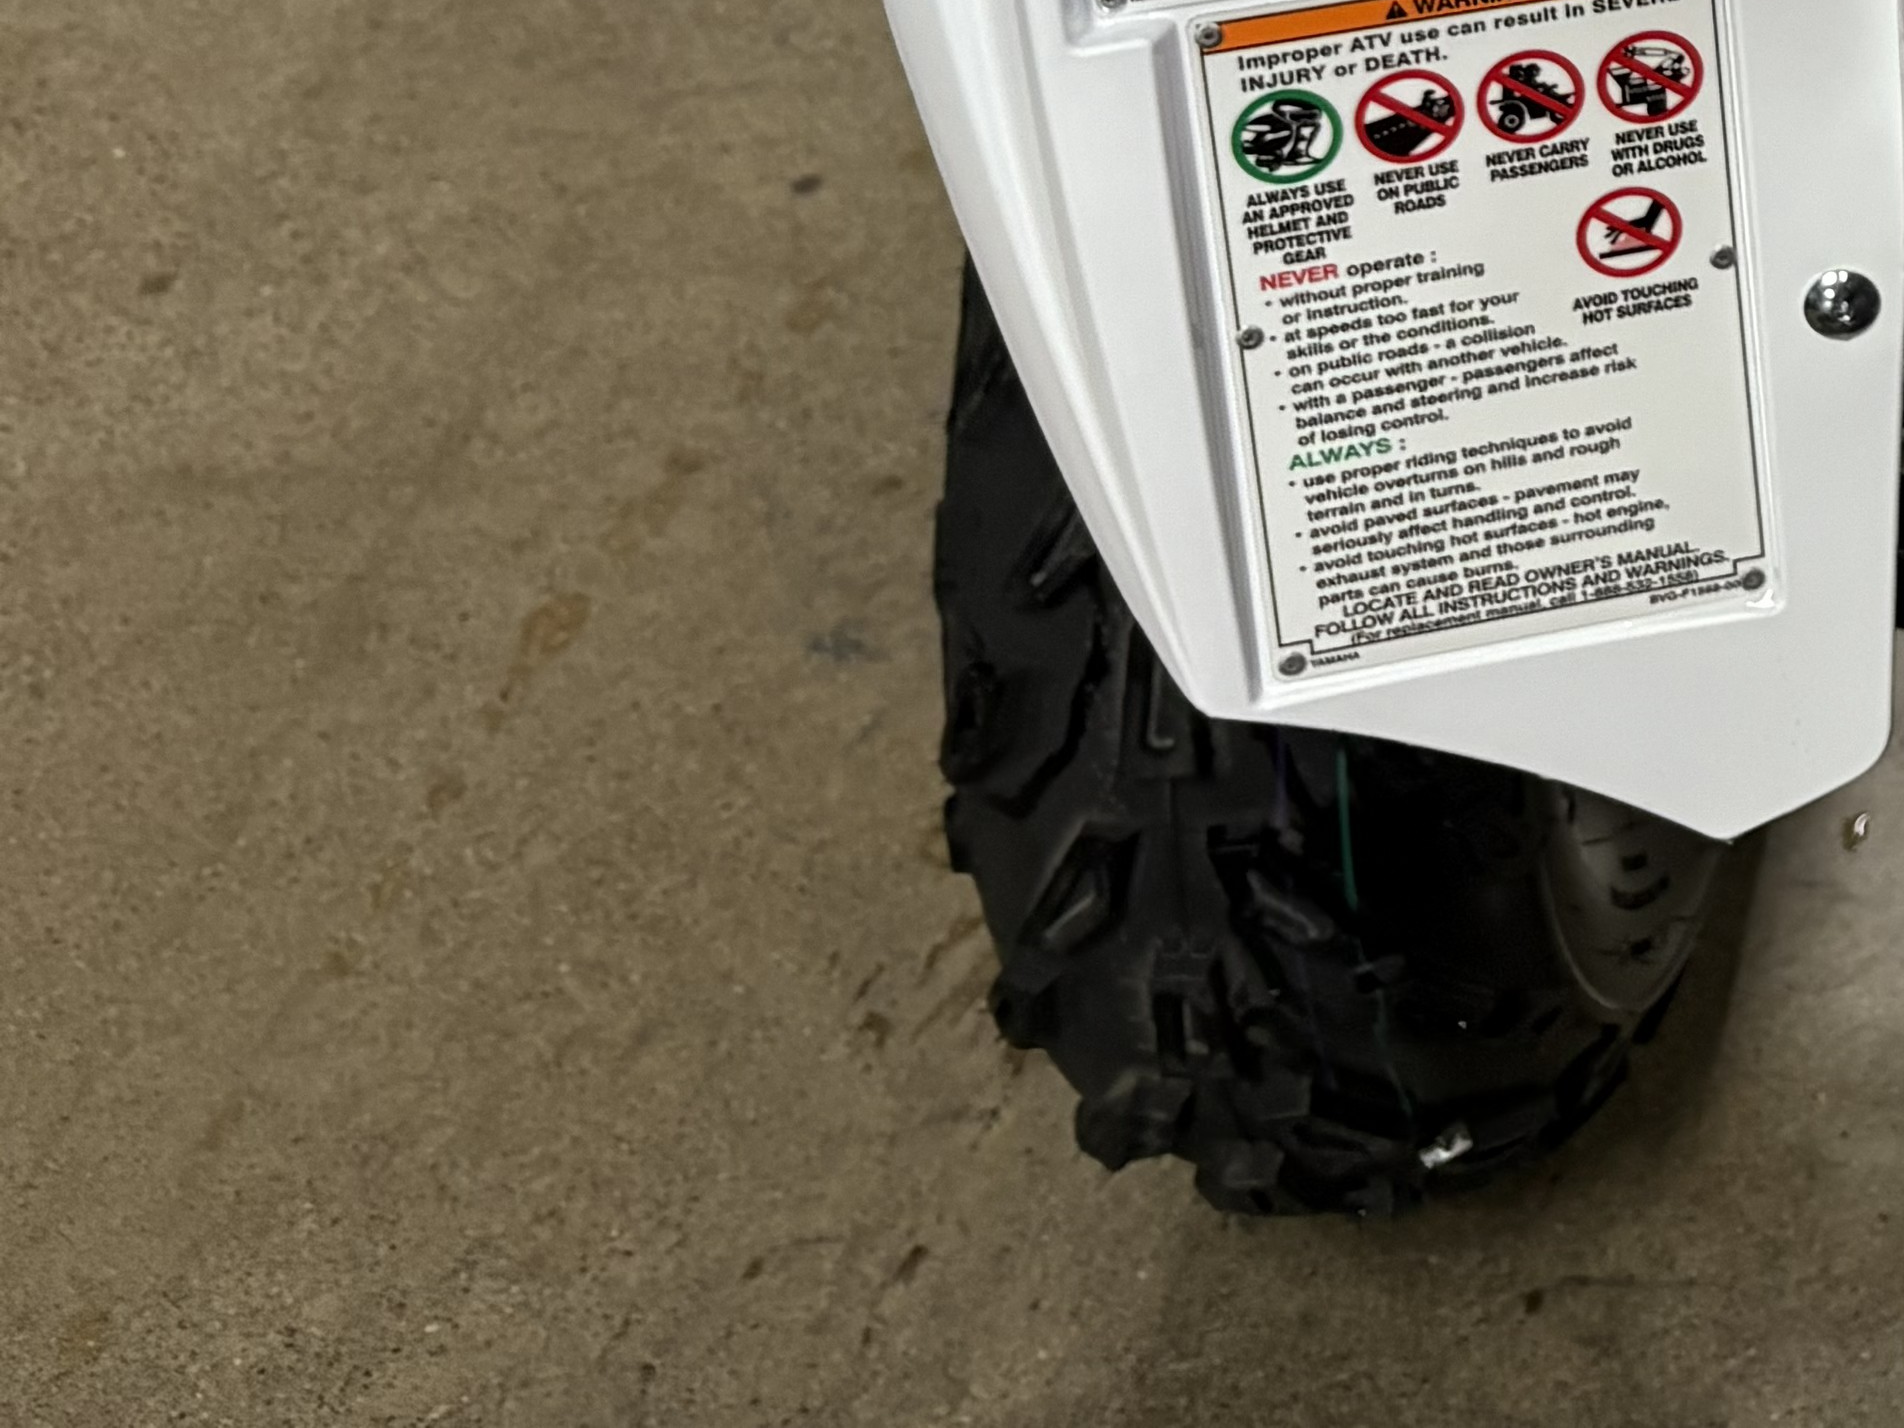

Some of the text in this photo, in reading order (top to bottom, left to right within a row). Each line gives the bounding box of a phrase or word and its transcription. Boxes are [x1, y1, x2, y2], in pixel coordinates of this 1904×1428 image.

[1237, 43, 1342, 71] Improper
[1349, 31, 1392, 53] ATV
[1400, 28, 1440, 45] use
[1446, 20, 1487, 37] can
[1493, 6, 1558, 30] result
[1240, 64, 1326, 93] INJURY
[1614, 119, 1698, 146] NEVER USE
[1485, 137, 1590, 168] NEVER CARRY
[1610, 133, 1705, 162] WITH DRUGS
[1636, 150, 1708, 174] ALCOHOL
[1373, 159, 1459, 187] NEVER USE
[1490, 153, 1589, 183] PASSENGERS
[1246, 178, 1347, 209] ALWAYS USE
[1402, 175, 1460, 197] PUBLIC
[1268, 193, 1355, 220] APPROVED
[1393, 193, 1447, 215] ROADS
[1246, 210, 1349, 240] HELMET AND
[1252, 225, 1352, 255] PROTECTIVE
[1282, 246, 1327, 266] GEAR
[1259, 252, 1425, 292] NEVER operate
[1278, 263, 1485, 308] without proper training
[1478, 292, 1519, 312] your
[1572, 276, 1699, 312] AVOID TOUCHING
[1615, 293, 1693, 319] SURFACES
